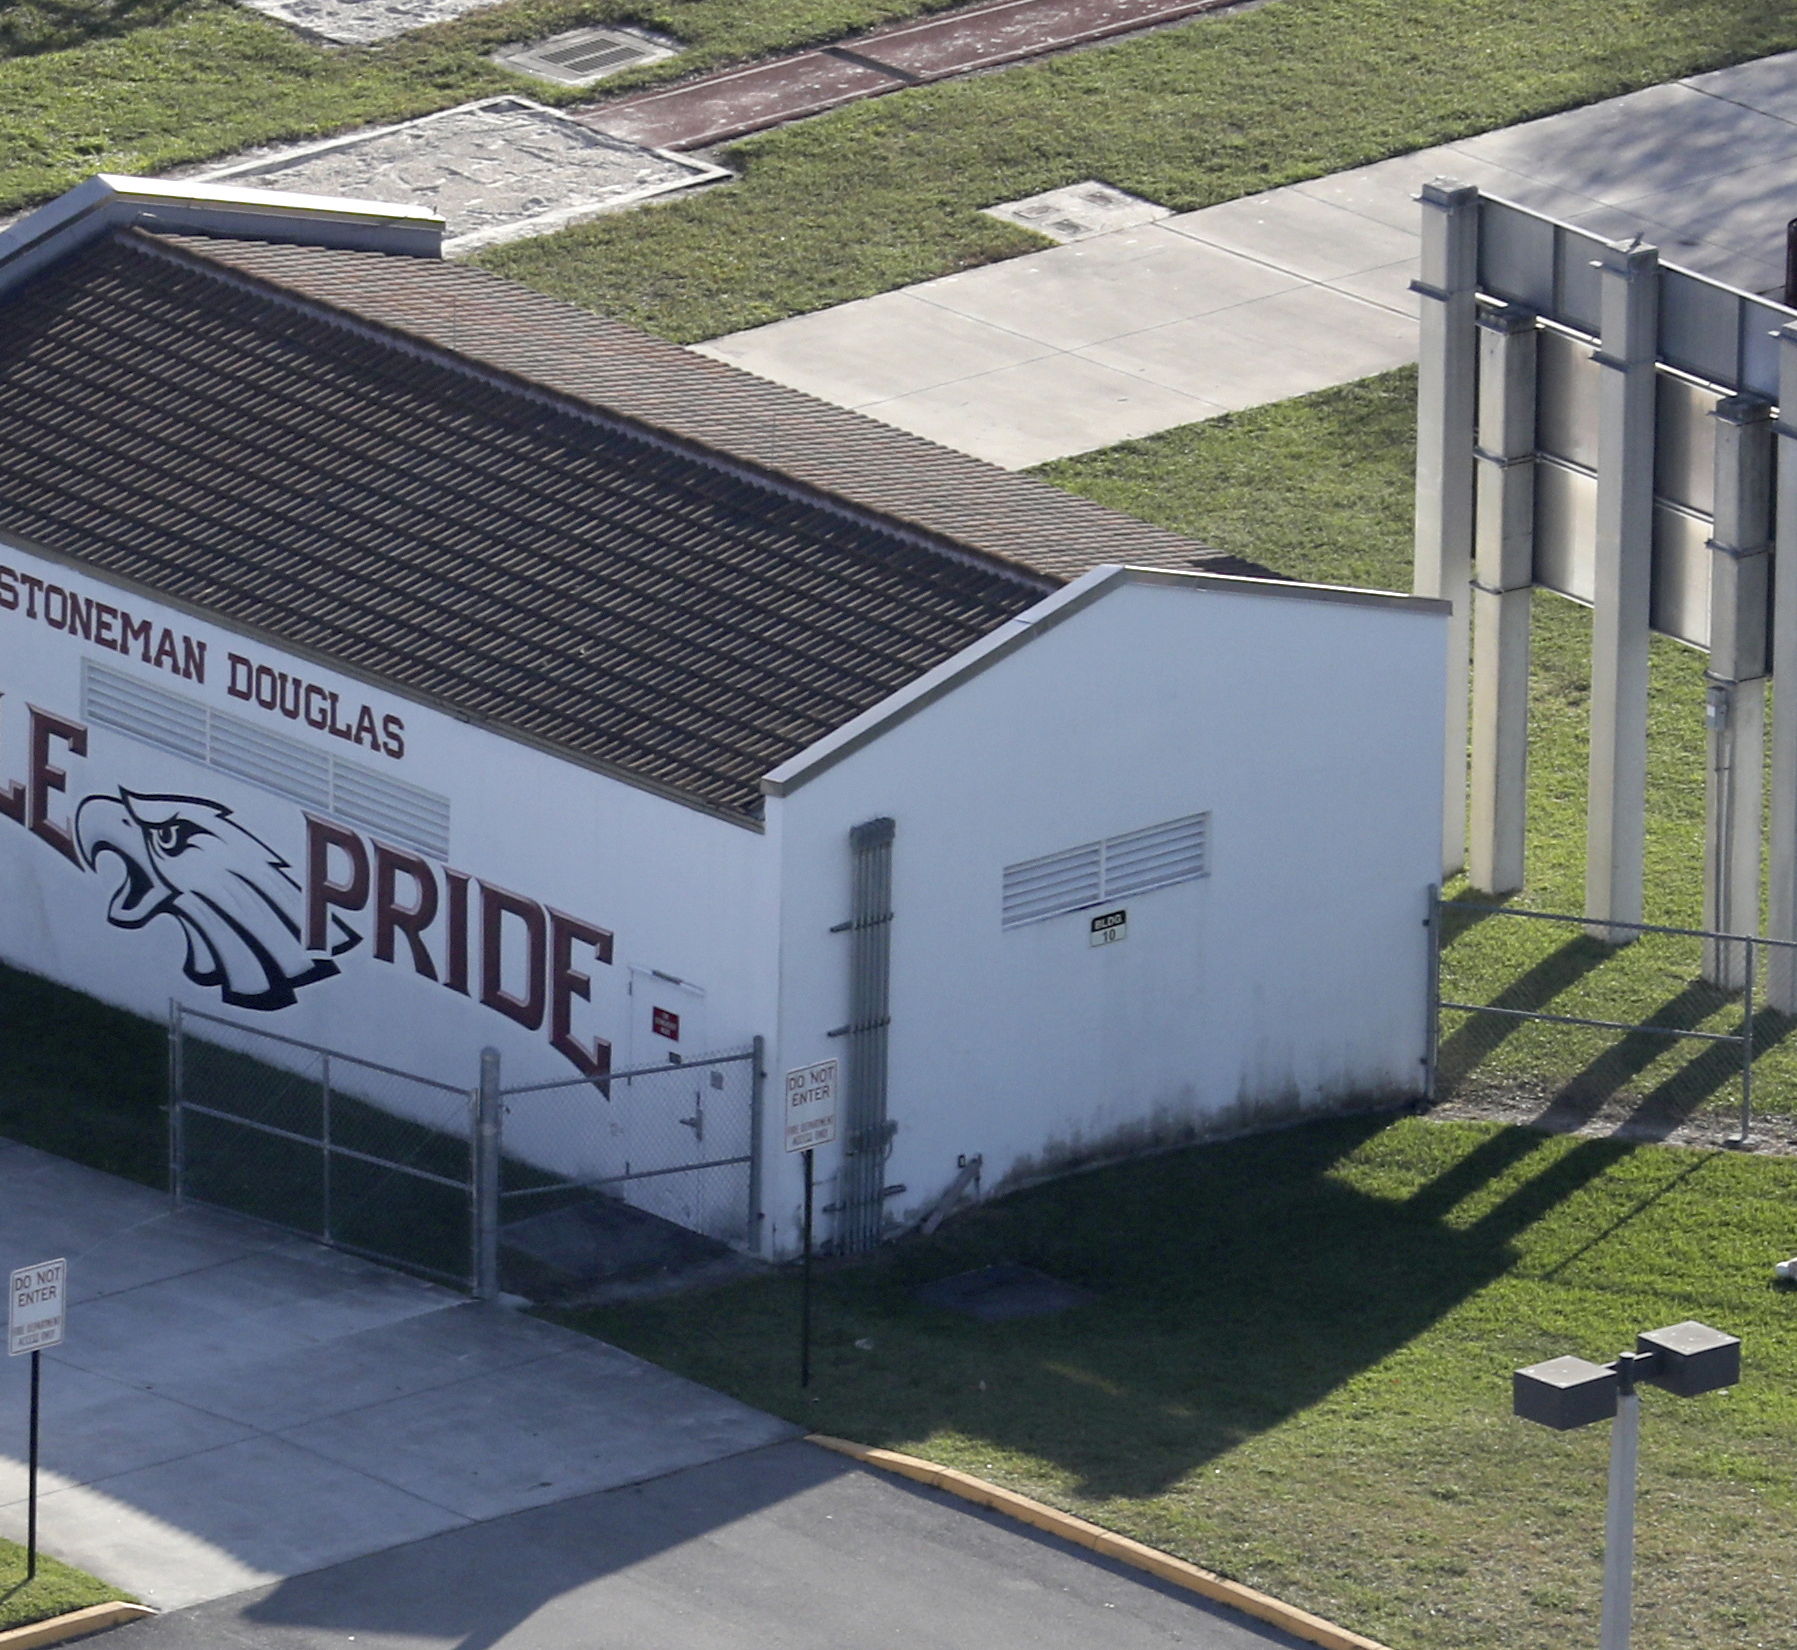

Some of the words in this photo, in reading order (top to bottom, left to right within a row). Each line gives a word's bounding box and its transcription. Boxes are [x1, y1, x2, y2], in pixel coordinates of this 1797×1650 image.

[227, 652, 405, 760] DOUGLAS
[1094, 914, 1122, 930] BLDG
[1103, 929, 1116, 942] 10
[300, 809, 614, 1102] PRIDE
[789, 1075, 804, 1091] DO
[810, 1066, 834, 1084] NOT
[792, 1085, 830, 1107] ENTER
[15, 1275, 31, 1291] DO
[37, 1266, 61, 1285] NOT
[18, 1285, 57, 1307] ENTER
